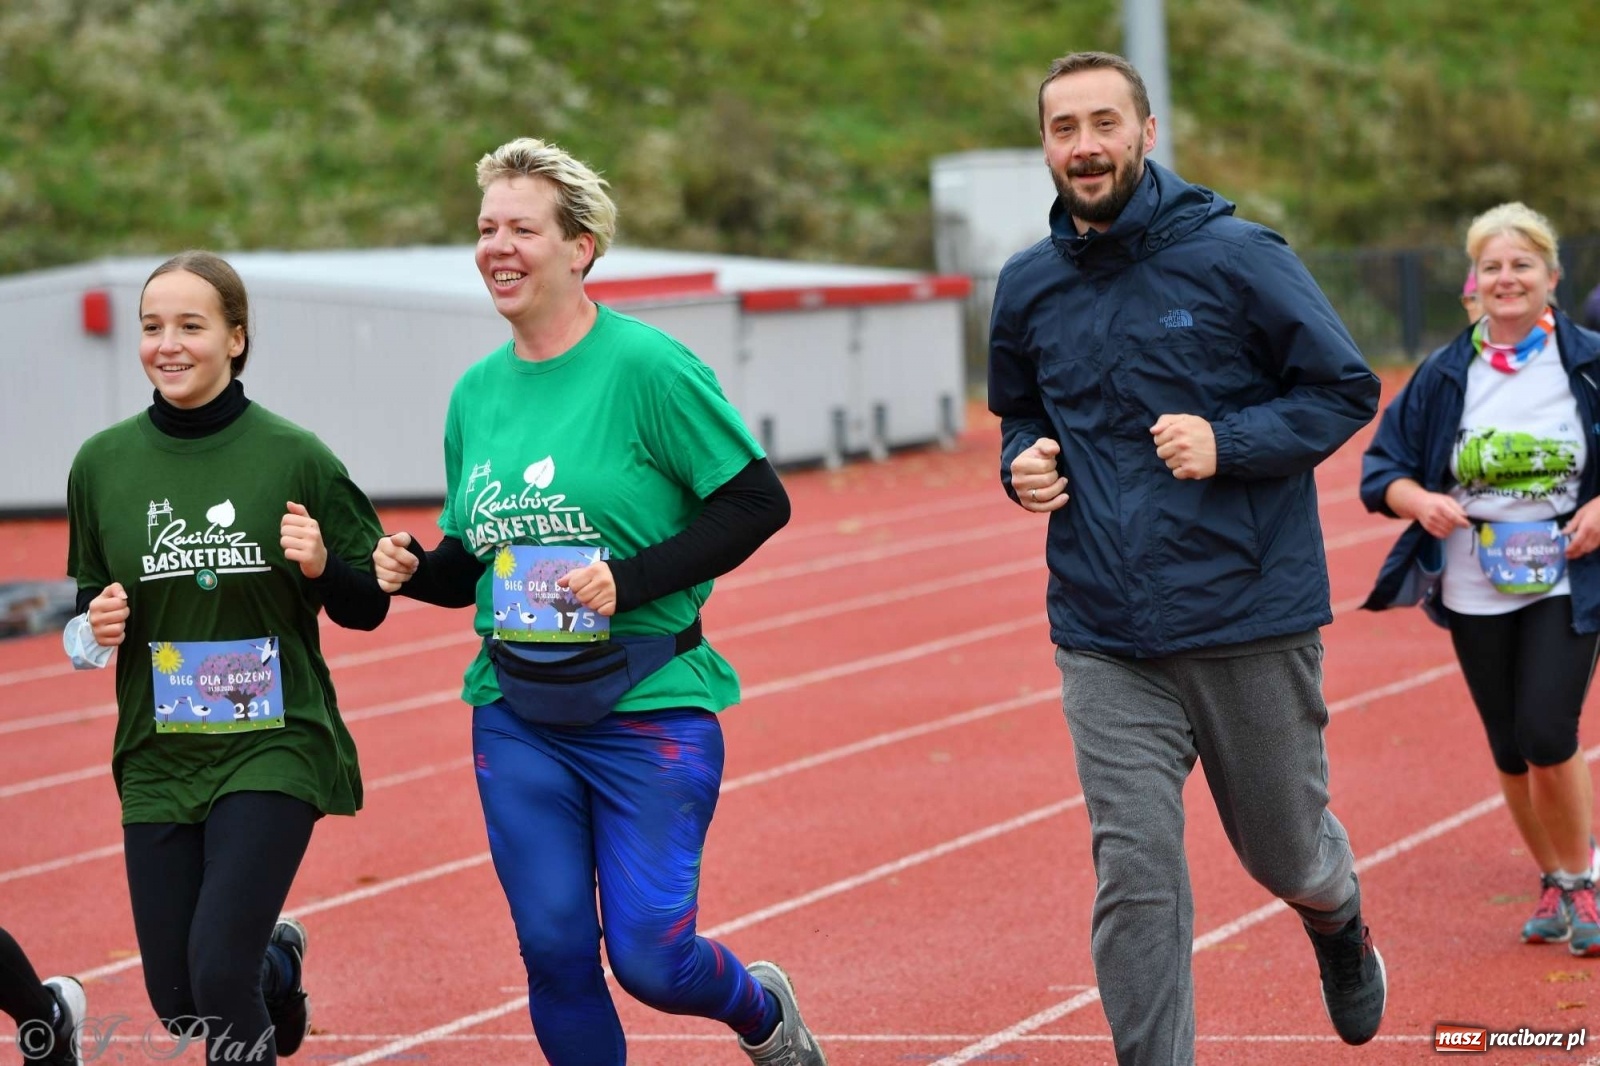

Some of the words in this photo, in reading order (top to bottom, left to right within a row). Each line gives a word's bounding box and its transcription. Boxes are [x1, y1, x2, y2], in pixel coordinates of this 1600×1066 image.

[1159, 315, 1181, 324] NORTH
[465, 512, 594, 549] BASKETBALL
[141, 546, 266, 574] BASKETBALL
[504, 580, 523, 592] BIEG
[528, 580, 548, 592] DLA
[553, 611, 595, 633] 175
[169, 674, 194, 686] BIEG
[200, 674, 221, 686] DLA
[233, 699, 270, 719] 221
